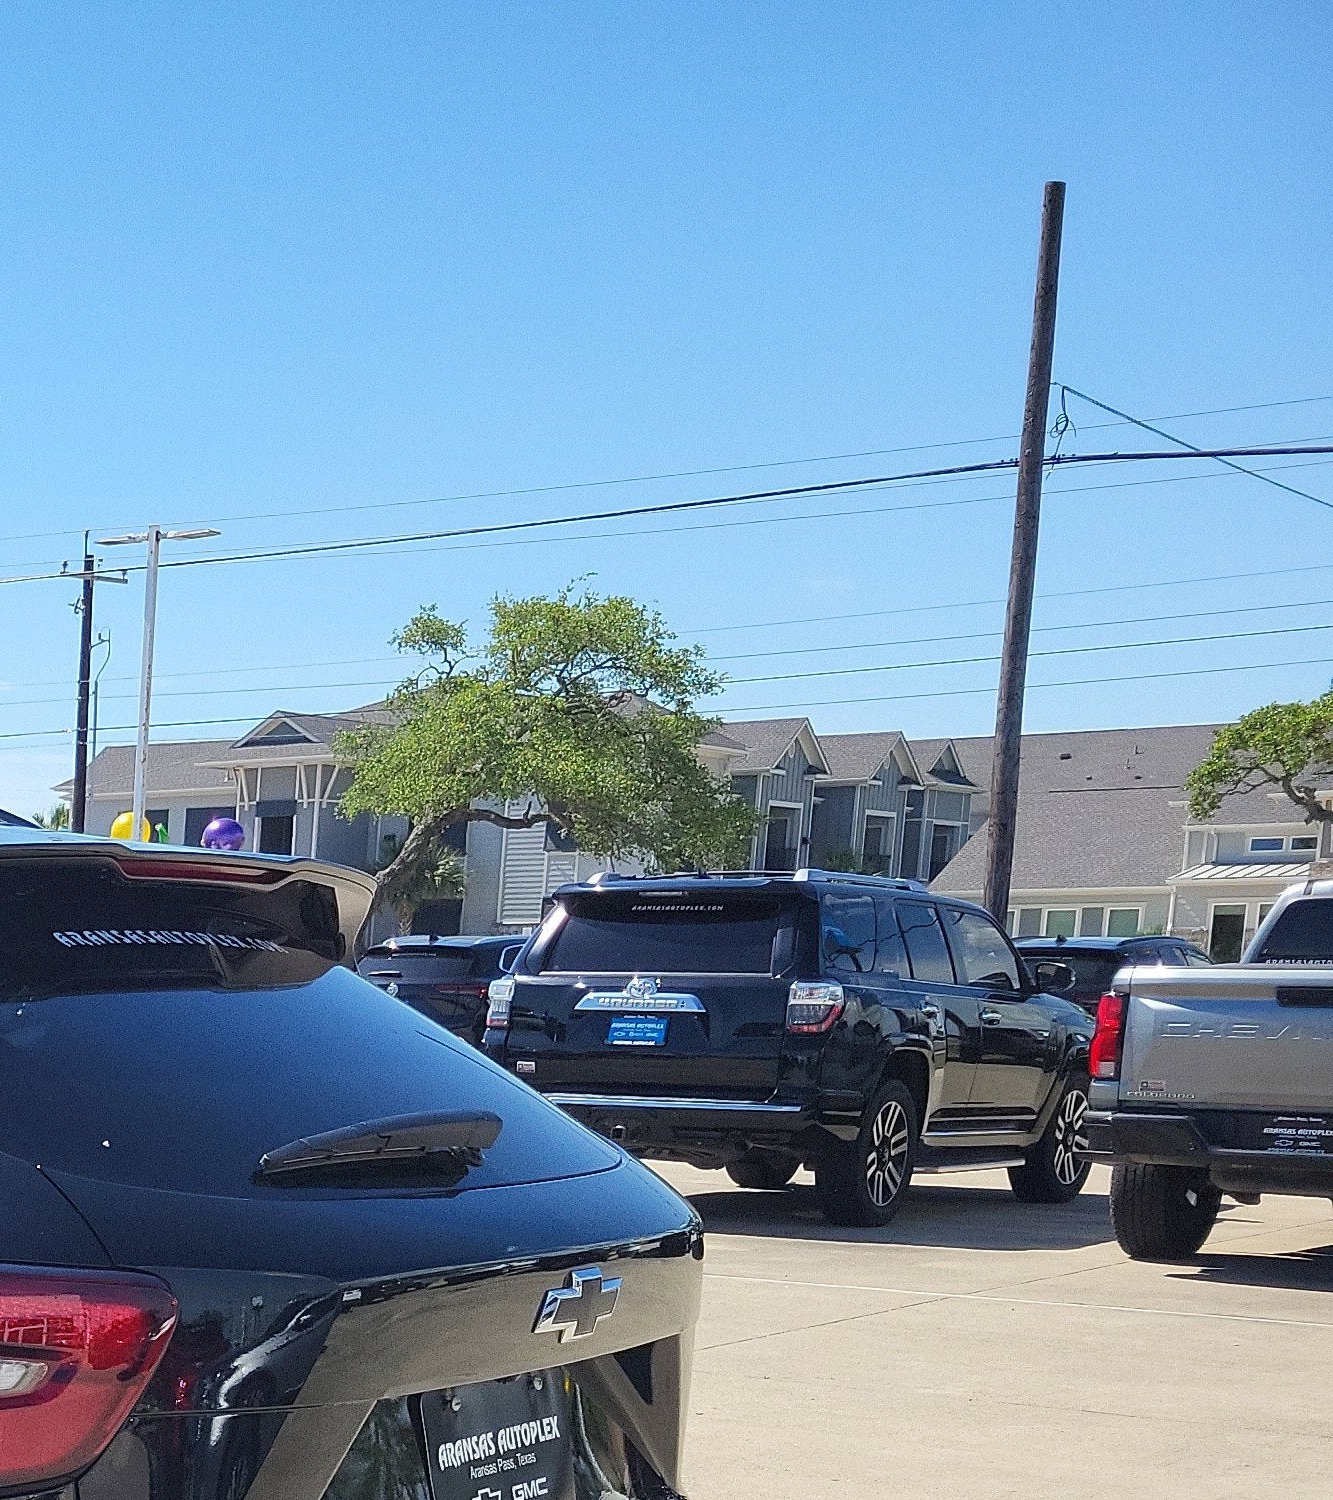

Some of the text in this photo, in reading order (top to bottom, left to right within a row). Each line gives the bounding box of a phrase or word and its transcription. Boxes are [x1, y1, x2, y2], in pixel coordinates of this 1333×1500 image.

[438, 1415, 561, 1471] ARANSAS AUTOPLEX
[470, 1452, 537, 1480] Aransas Pass, Texas
